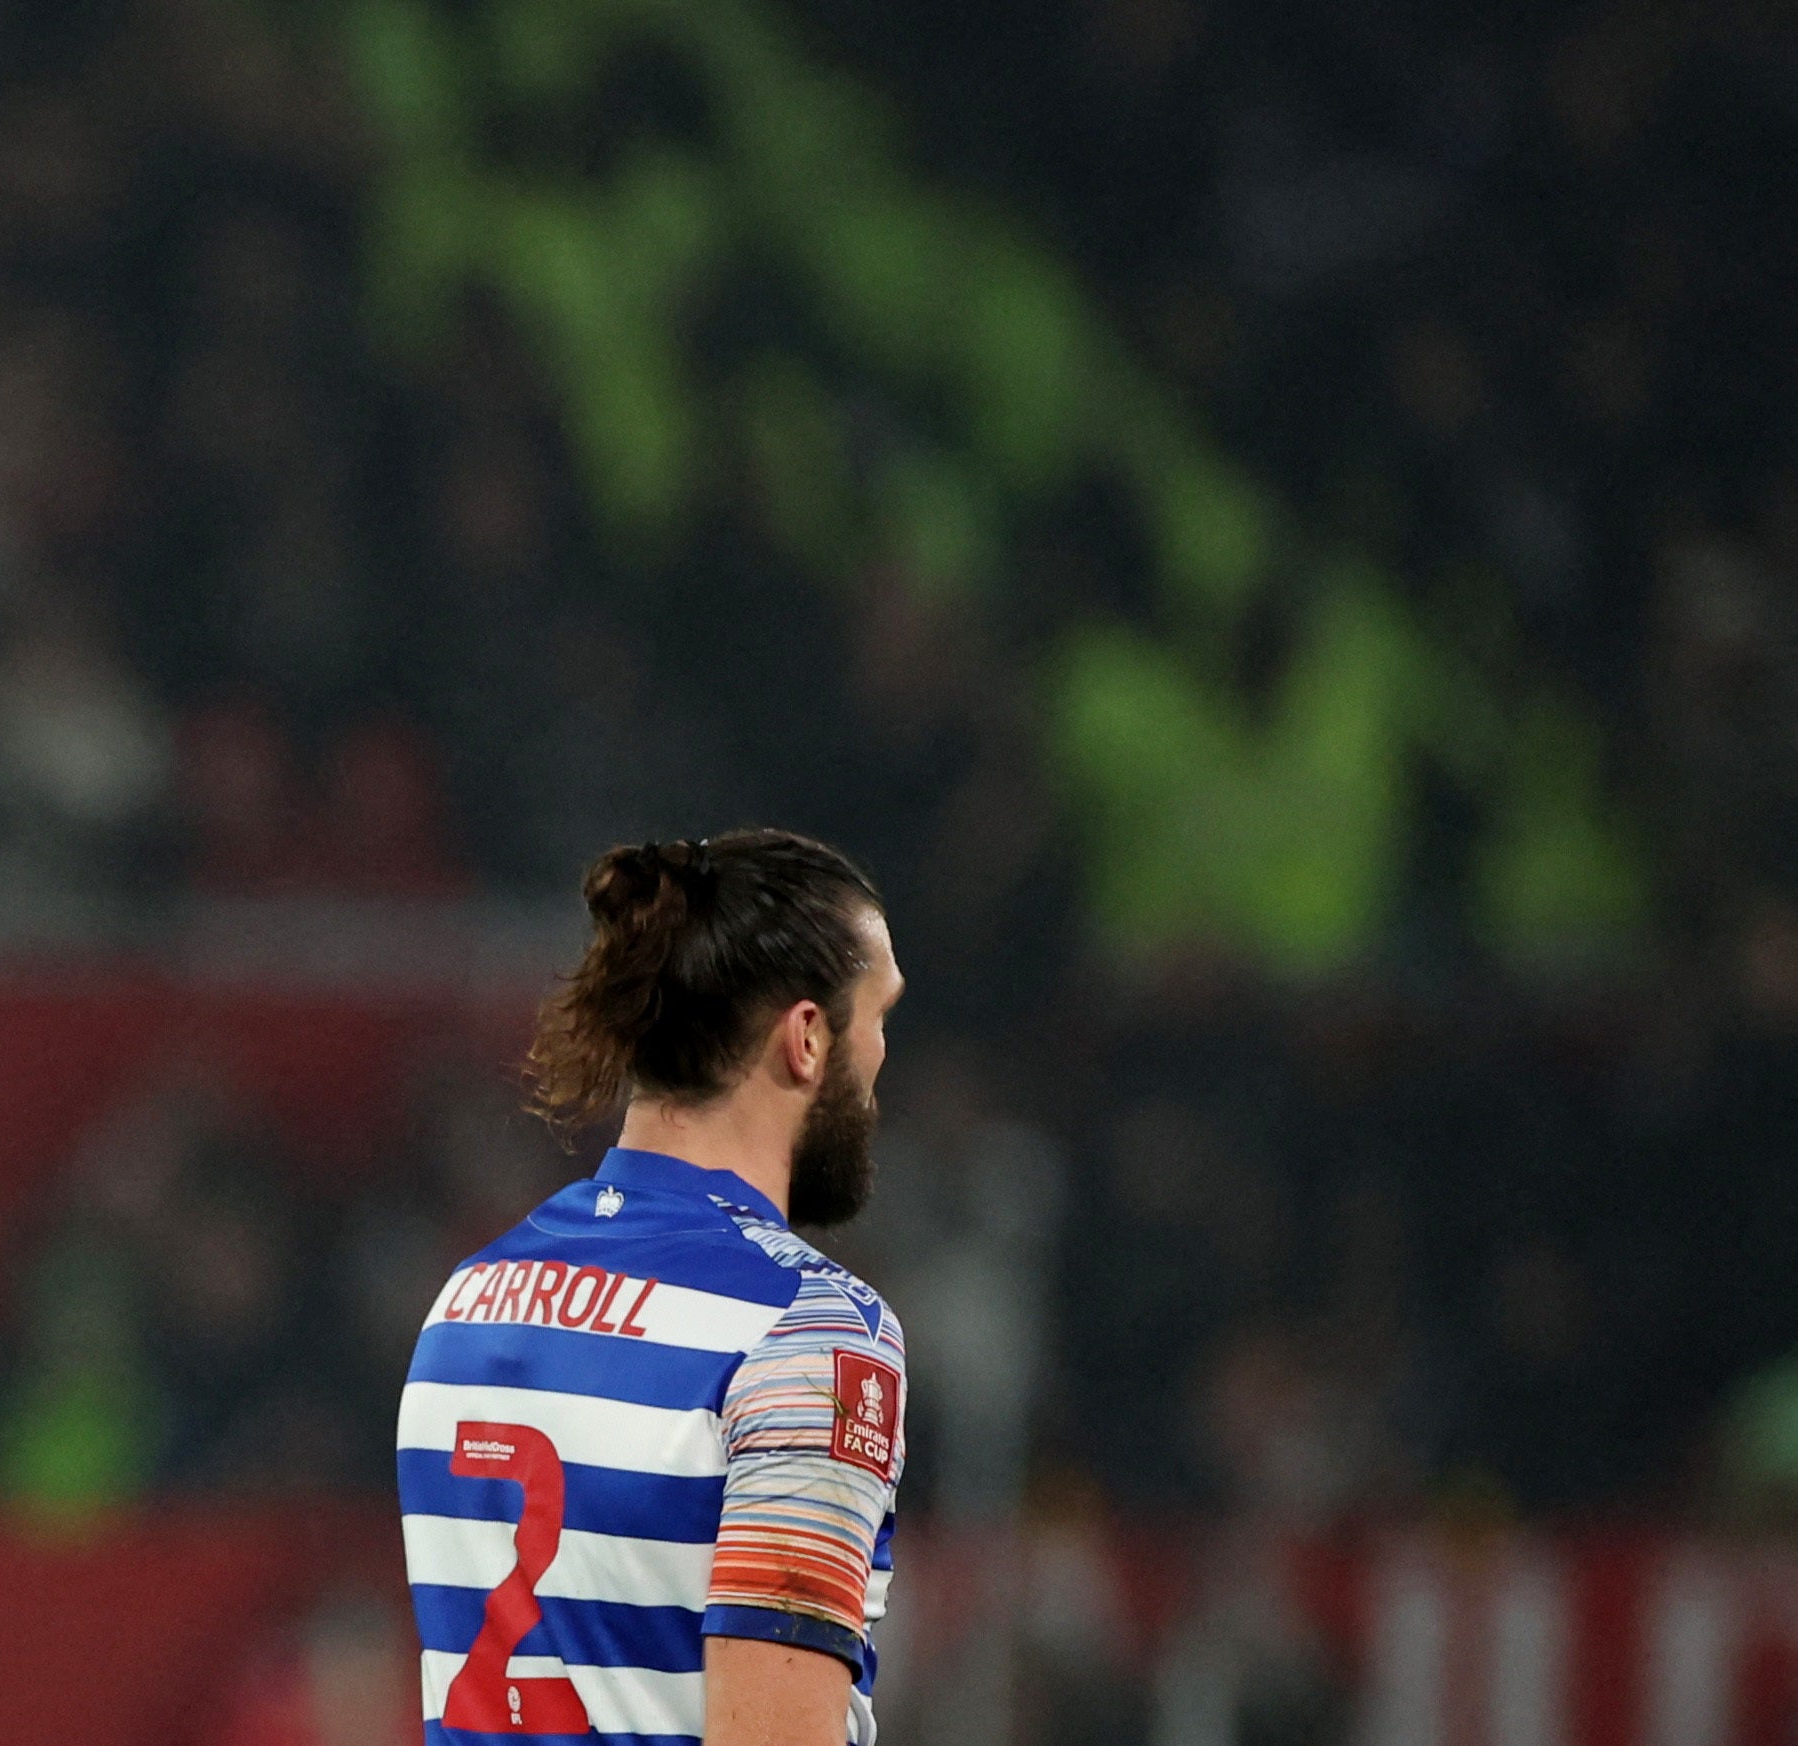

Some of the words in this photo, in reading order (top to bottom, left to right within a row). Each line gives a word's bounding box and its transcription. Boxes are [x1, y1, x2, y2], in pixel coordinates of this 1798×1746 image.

[444, 1259, 659, 1337] CARROLL
[843, 1433, 863, 1453] FA
[864, 1440, 889, 1464] CUP
[845, 1418, 890, 1450] Emirates
[441, 1420, 592, 1735] 2
